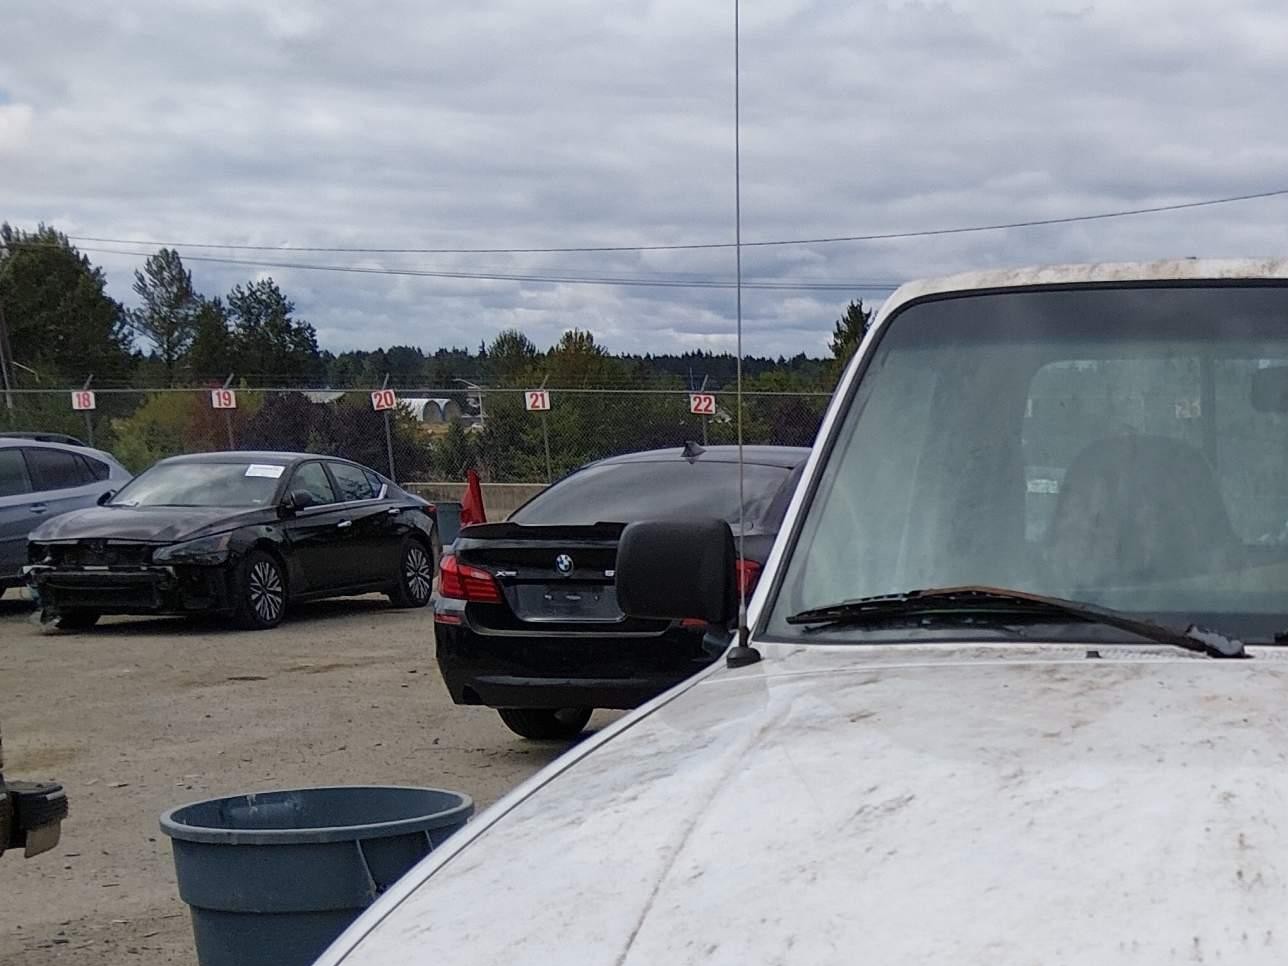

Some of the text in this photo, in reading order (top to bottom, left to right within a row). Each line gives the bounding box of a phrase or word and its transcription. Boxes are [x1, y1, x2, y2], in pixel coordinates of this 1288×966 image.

[76, 392, 91, 408] 18
[217, 391, 232, 407] 19
[374, 392, 394, 408] 20
[530, 392, 546, 408] 21
[693, 396, 713, 412] 22
